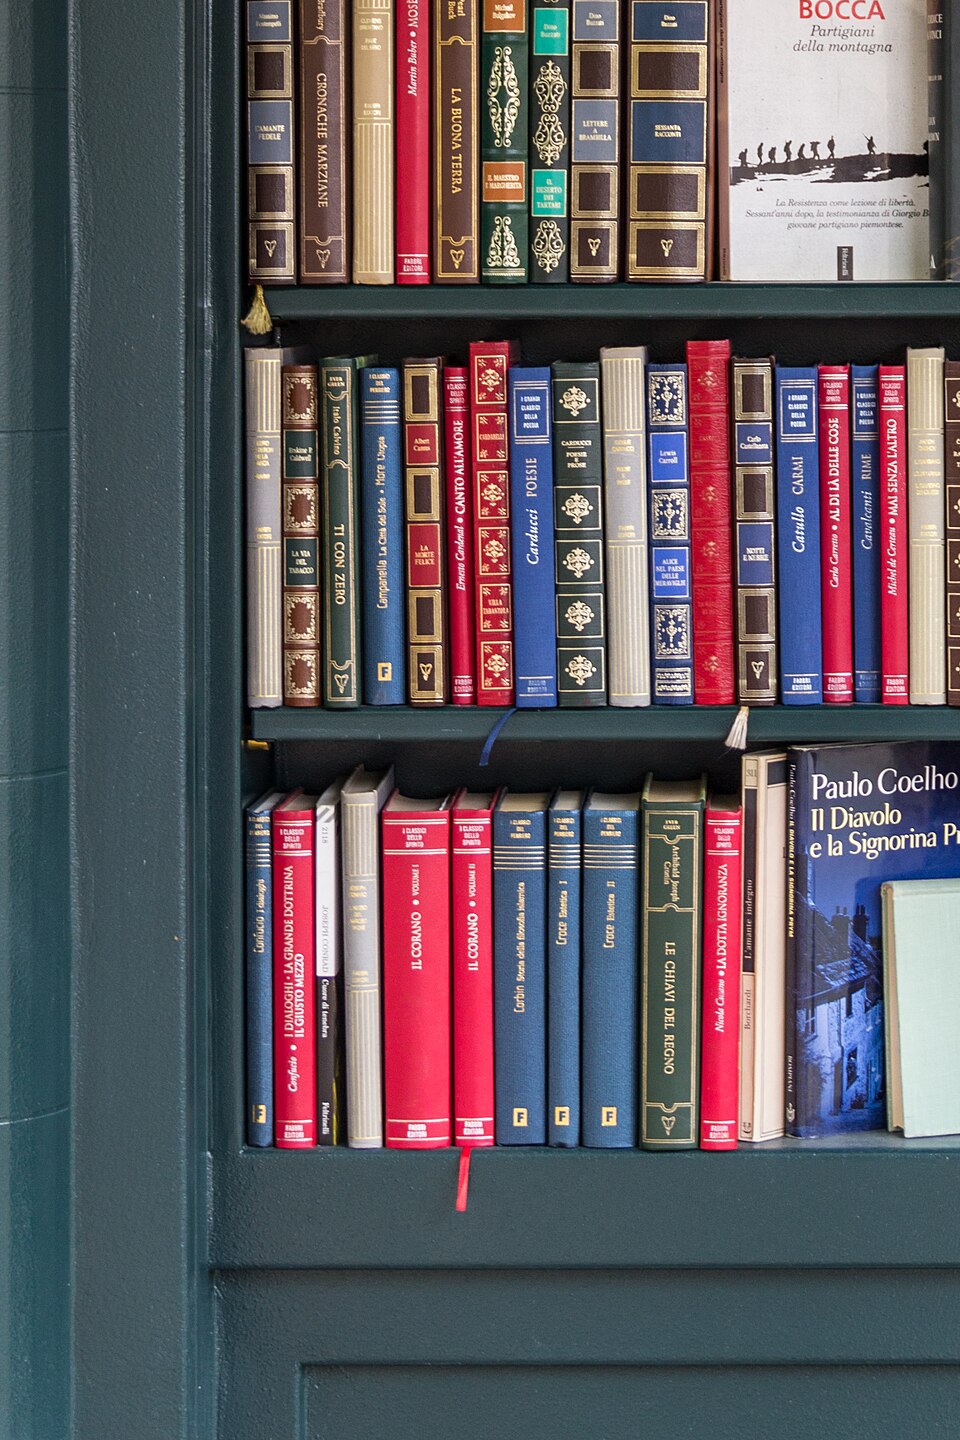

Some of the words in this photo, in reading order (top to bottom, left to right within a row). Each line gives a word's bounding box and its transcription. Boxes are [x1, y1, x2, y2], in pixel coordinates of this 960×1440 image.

[800, 0, 885, 20] BOCCA
[793, 40, 823, 51] della
[829, 42, 892, 54] montagna
[811, 25, 874, 39] Partigiani
[408, 40, 417, 64] Buber
[408, 67, 417, 96] Martin
[452, 88, 461, 103] LA
[317, 73, 327, 138] CRONACHE
[452, 108, 462, 149] BUONA
[318, 145, 328, 207] MARZIANE
[452, 154, 462, 193] TERRA
[829, 418, 838, 444] COSE
[887, 419, 897, 457] L'ALTRO
[454, 421, 464, 475] ALL'AMORE
[829, 447, 839, 476] DELLE
[526, 458, 537, 496] POESIE
[792, 457, 803, 494] CARMI
[861, 455, 871, 479] RIME
[888, 461, 897, 492] SENZA
[455, 477, 465, 514] CANTO
[829, 494, 839, 505] DI
[888, 496, 898, 515] MAI
[334, 524, 344, 535] TI
[791, 507, 805, 552] Catullo
[830, 508, 840, 521] AL
[861, 491, 872, 549] Cavalcanti
[525, 509, 539, 564] Carducci
[335, 542, 345, 567] CON
[335, 574, 345, 604] ZERO
[811, 771, 873, 800] Paulo
[878, 765, 959, 795] Coelho
[811, 808, 824, 832] Il
[830, 802, 902, 830] Diavolo
[809, 841, 822, 858] e
[827, 834, 843, 857] la
[849, 828, 937, 860] Signorina
[468, 870, 476, 897] VOLUME
[411, 912, 422, 958] CORANO
[467, 913, 478, 959] CORANO
[665, 942, 675, 955] LE
[294, 954, 304, 987] MEZZO
[411, 959, 422, 970] IL
[468, 961, 478, 971] IL
[665, 961, 675, 1001] CHIAVI
[295, 989, 304, 1026] GIUSTO
[665, 1008, 674, 1029] DEL
[295, 1028, 304, 1037] IL
[664, 1035, 674, 1074] REGNO
[288, 1057, 299, 1091] Confucio
